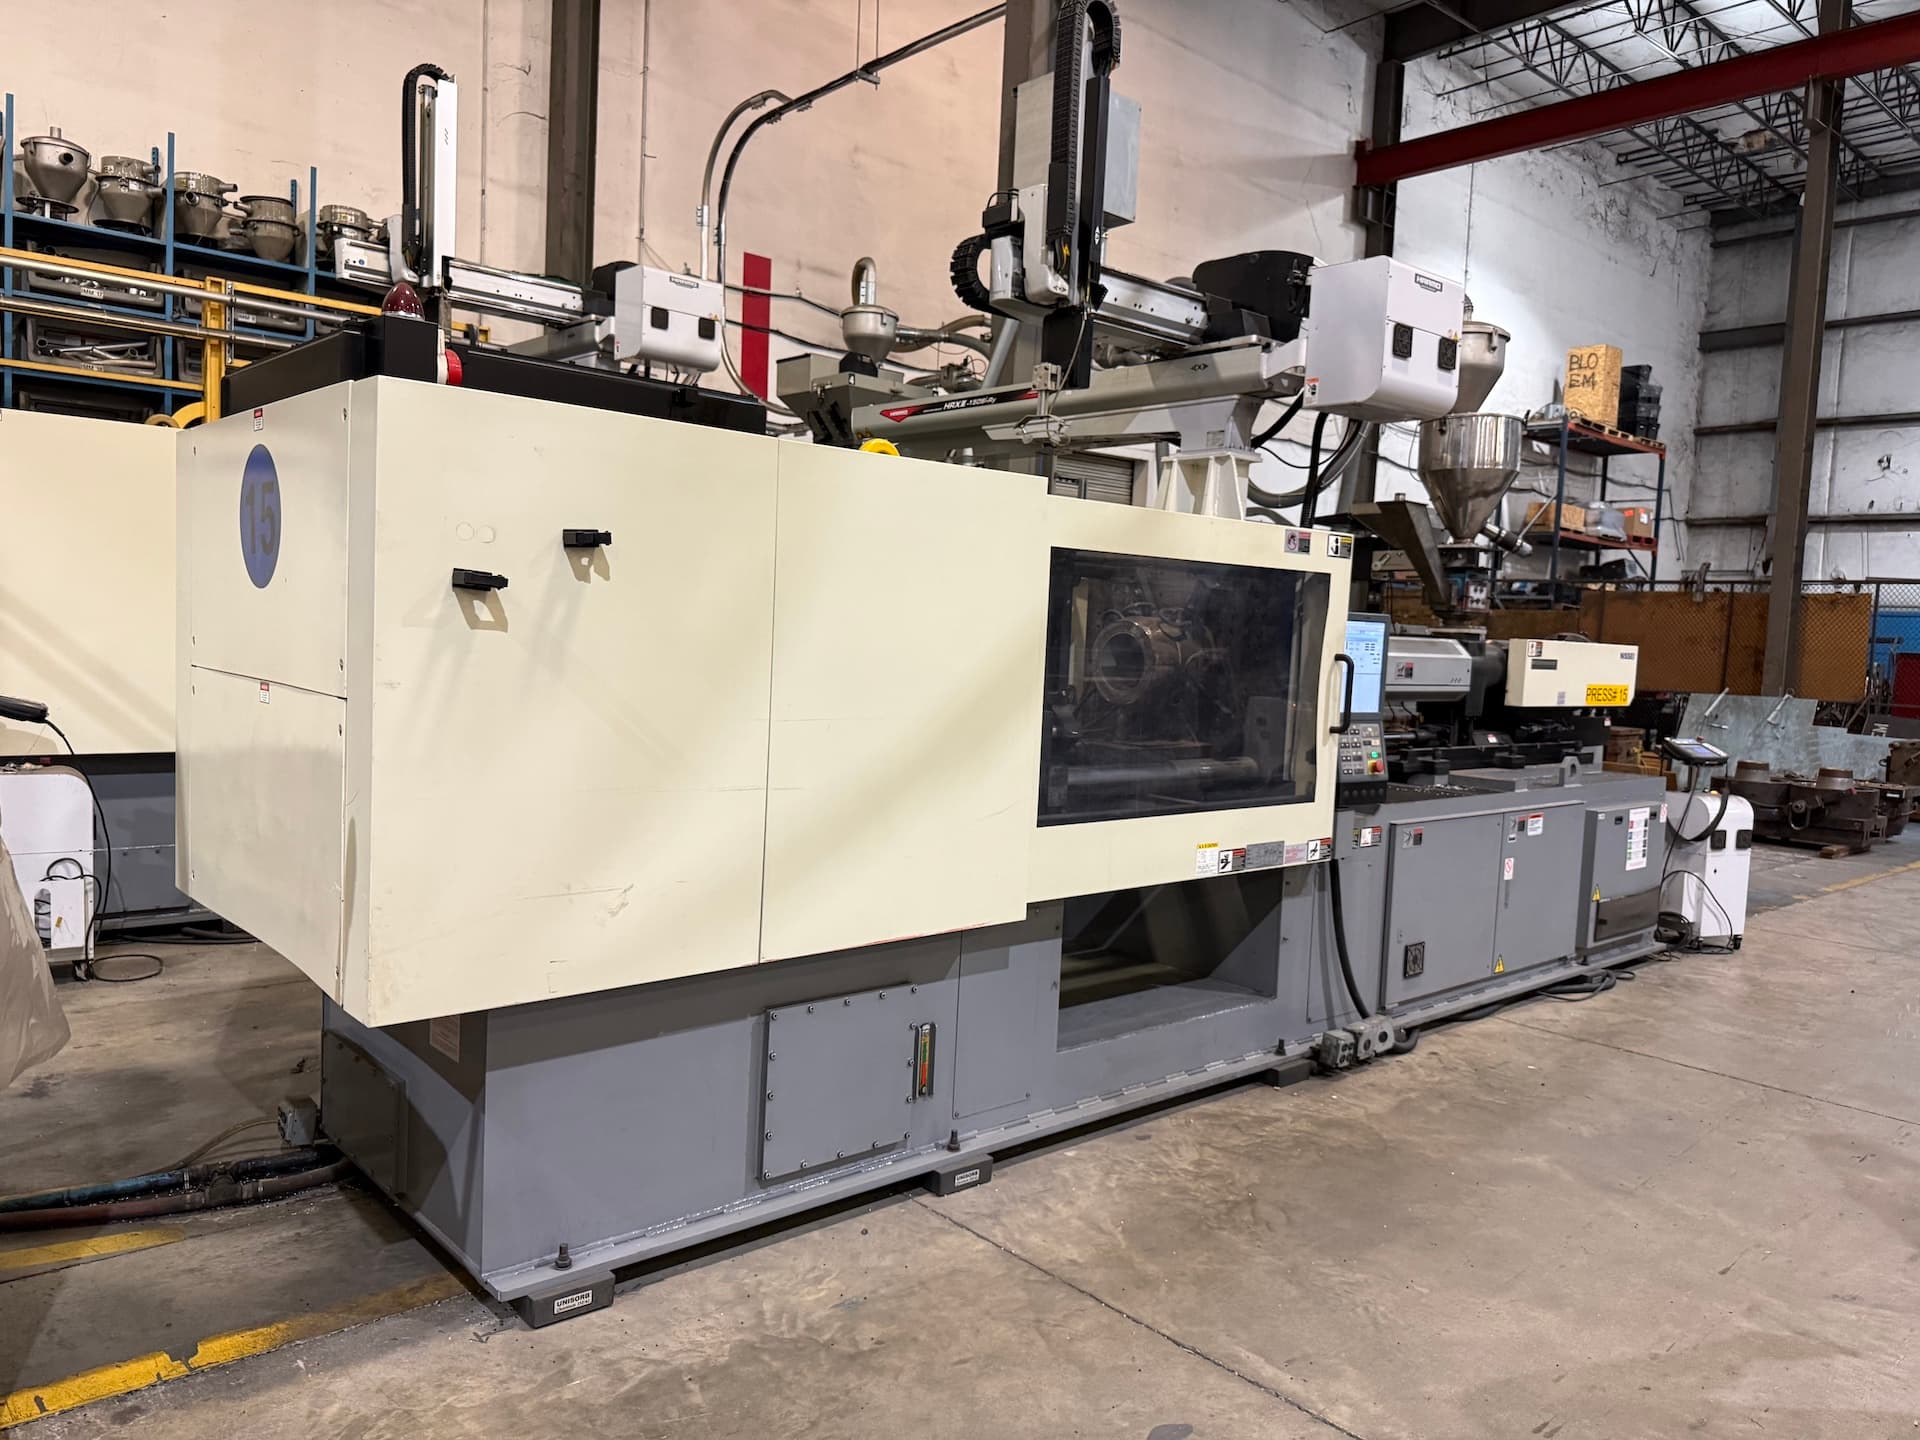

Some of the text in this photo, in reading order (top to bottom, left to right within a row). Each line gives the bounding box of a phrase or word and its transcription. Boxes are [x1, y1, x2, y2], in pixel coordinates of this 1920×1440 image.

[1569, 352, 1598, 371] BLO
[245, 480, 275, 557] 15
[1586, 687, 1629, 703] PRESS# 15
[556, 1292, 590, 1307] UNISORB
